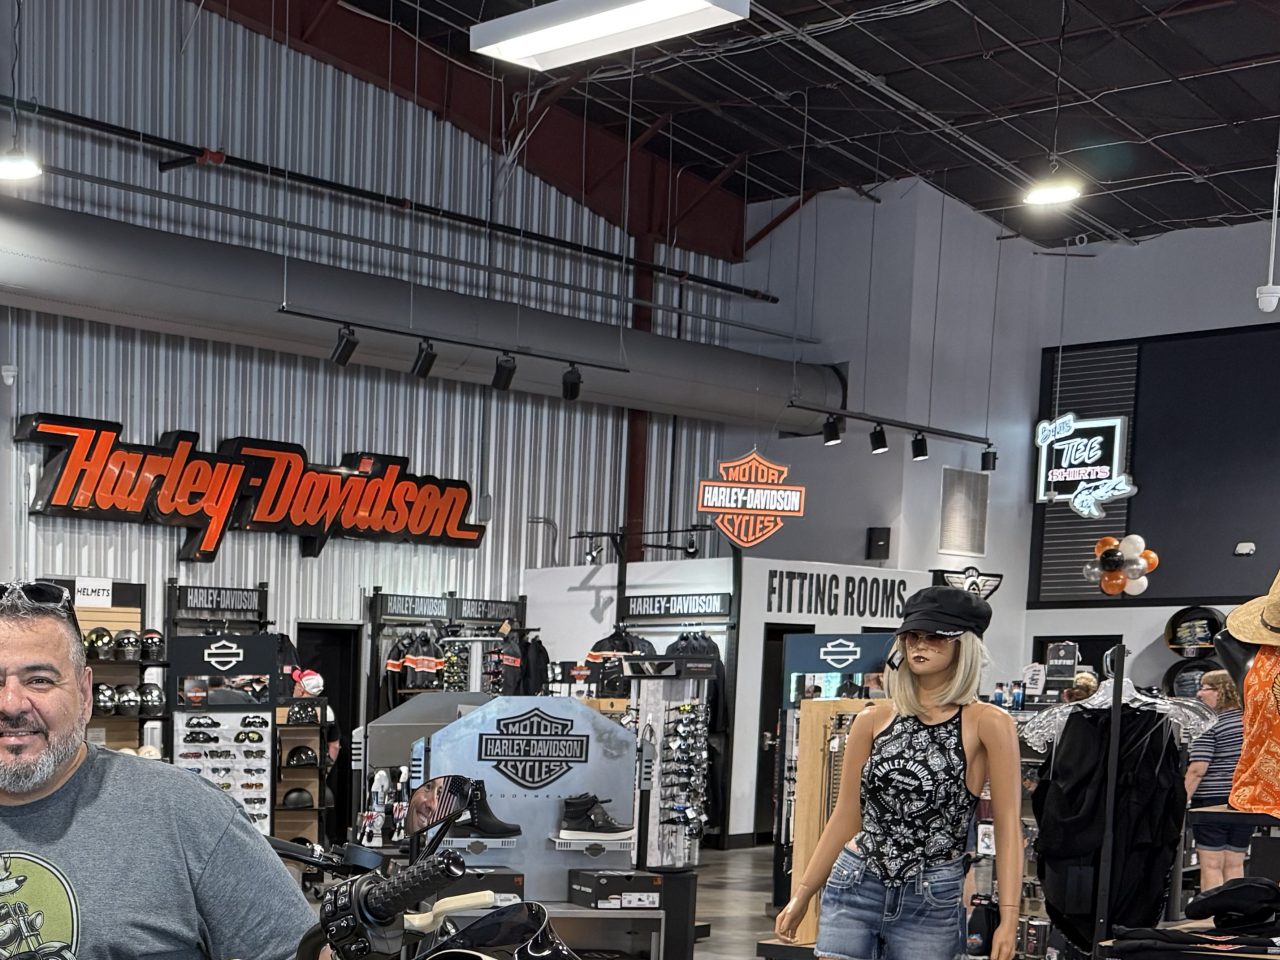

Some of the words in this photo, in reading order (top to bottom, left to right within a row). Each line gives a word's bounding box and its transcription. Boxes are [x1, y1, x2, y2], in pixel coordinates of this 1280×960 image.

[1053, 436, 1104, 468] TEE
[728, 460, 779, 484] MOTOR
[1048, 466, 1111, 482] SHIRTS
[36, 423, 481, 552] Harley-Davidson
[703, 486, 800, 511] HARLEY-DAVIDSON
[724, 514, 775, 542] CYCLES
[76, 587, 110, 598] HELMETS
[187, 588, 258, 610] HARLEY-DAVIDSON
[767, 570, 840, 617] FITTING
[843, 576, 907, 619] ROOMS
[388, 596, 447, 617] HARLEY-DAVIDSON
[629, 595, 721, 615] HARLEY-DAVIDSON
[508, 717, 562, 735] MOTOR
[487, 739, 581, 758] HARLEY-DAVIDSON
[507, 761, 562, 783] CYCLES
[873, 760, 934, 791] HARLEY-DAVIDSON
